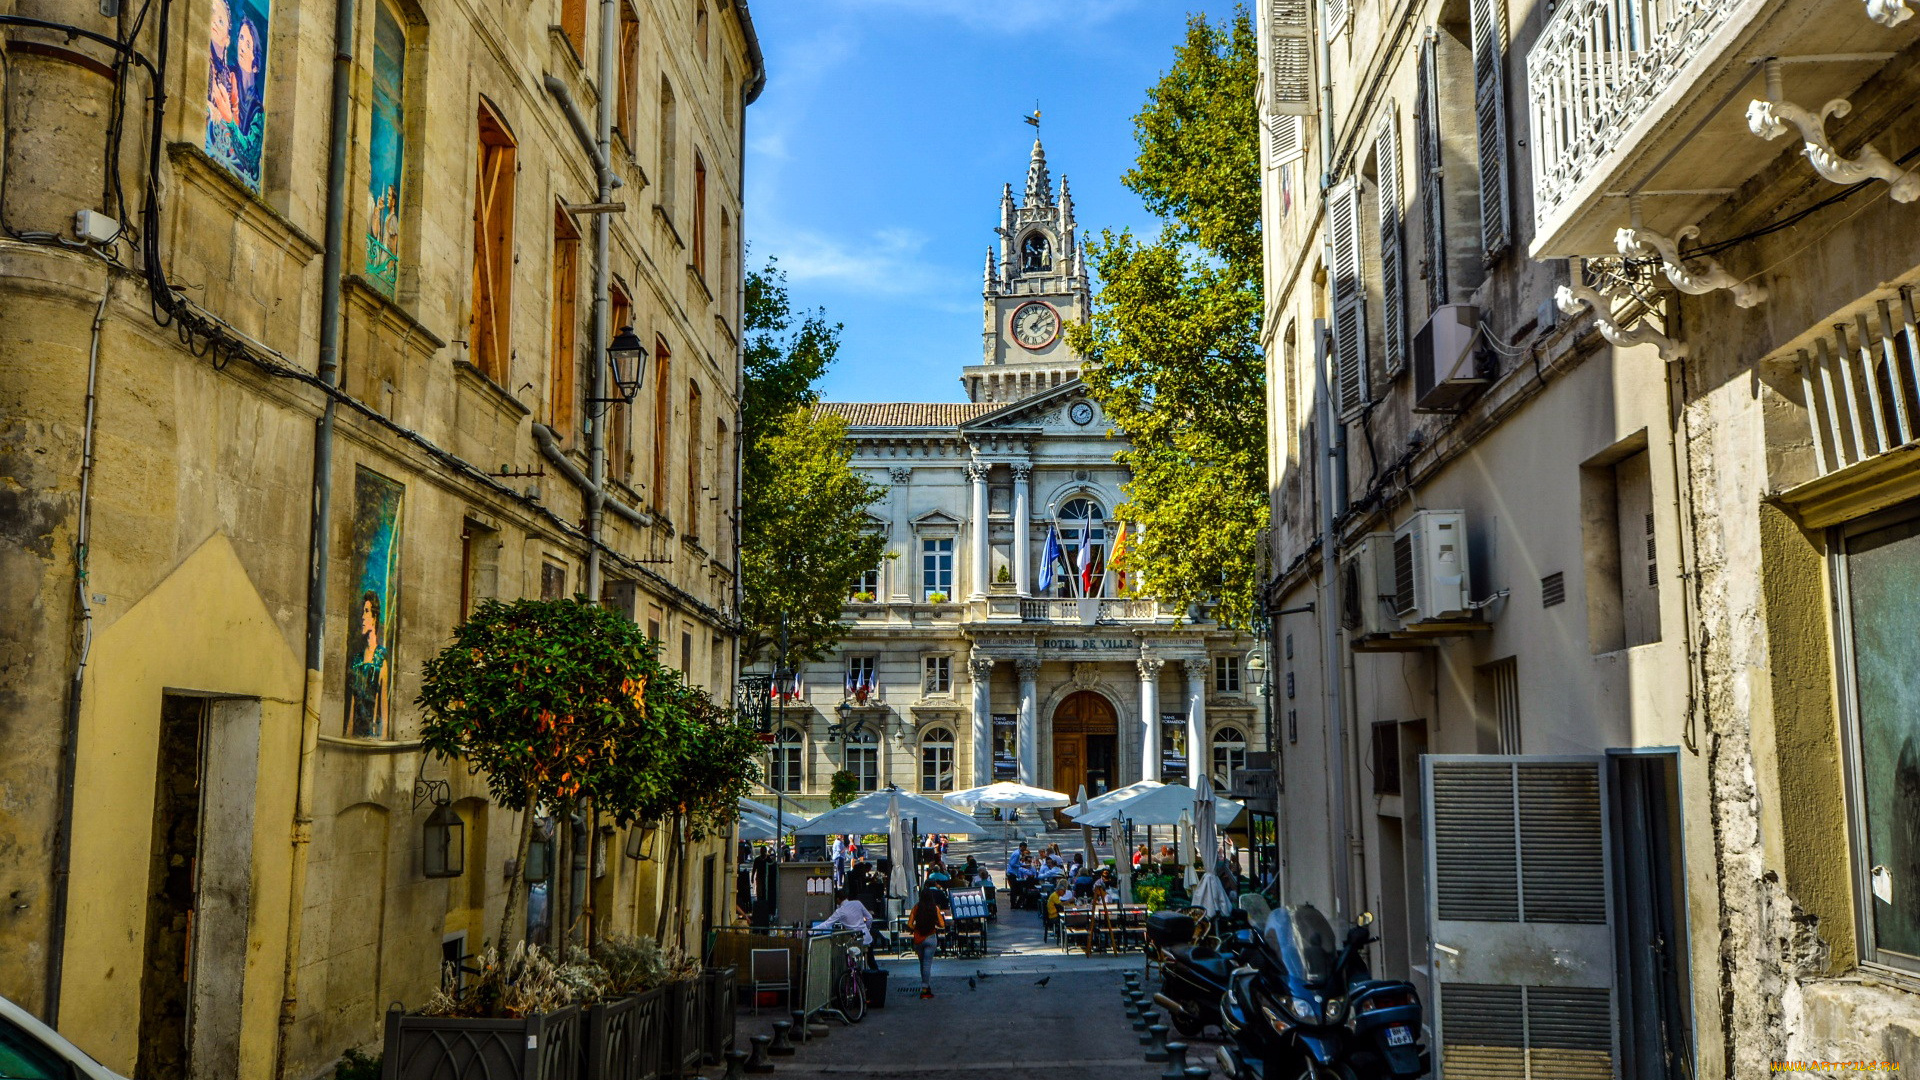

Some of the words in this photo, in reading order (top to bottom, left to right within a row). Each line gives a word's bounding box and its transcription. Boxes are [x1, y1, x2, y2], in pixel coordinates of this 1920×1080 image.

[1043, 640, 1078, 649] HOTEL
[1082, 640, 1096, 649] DE
[1101, 640, 1133, 649] VILLE
